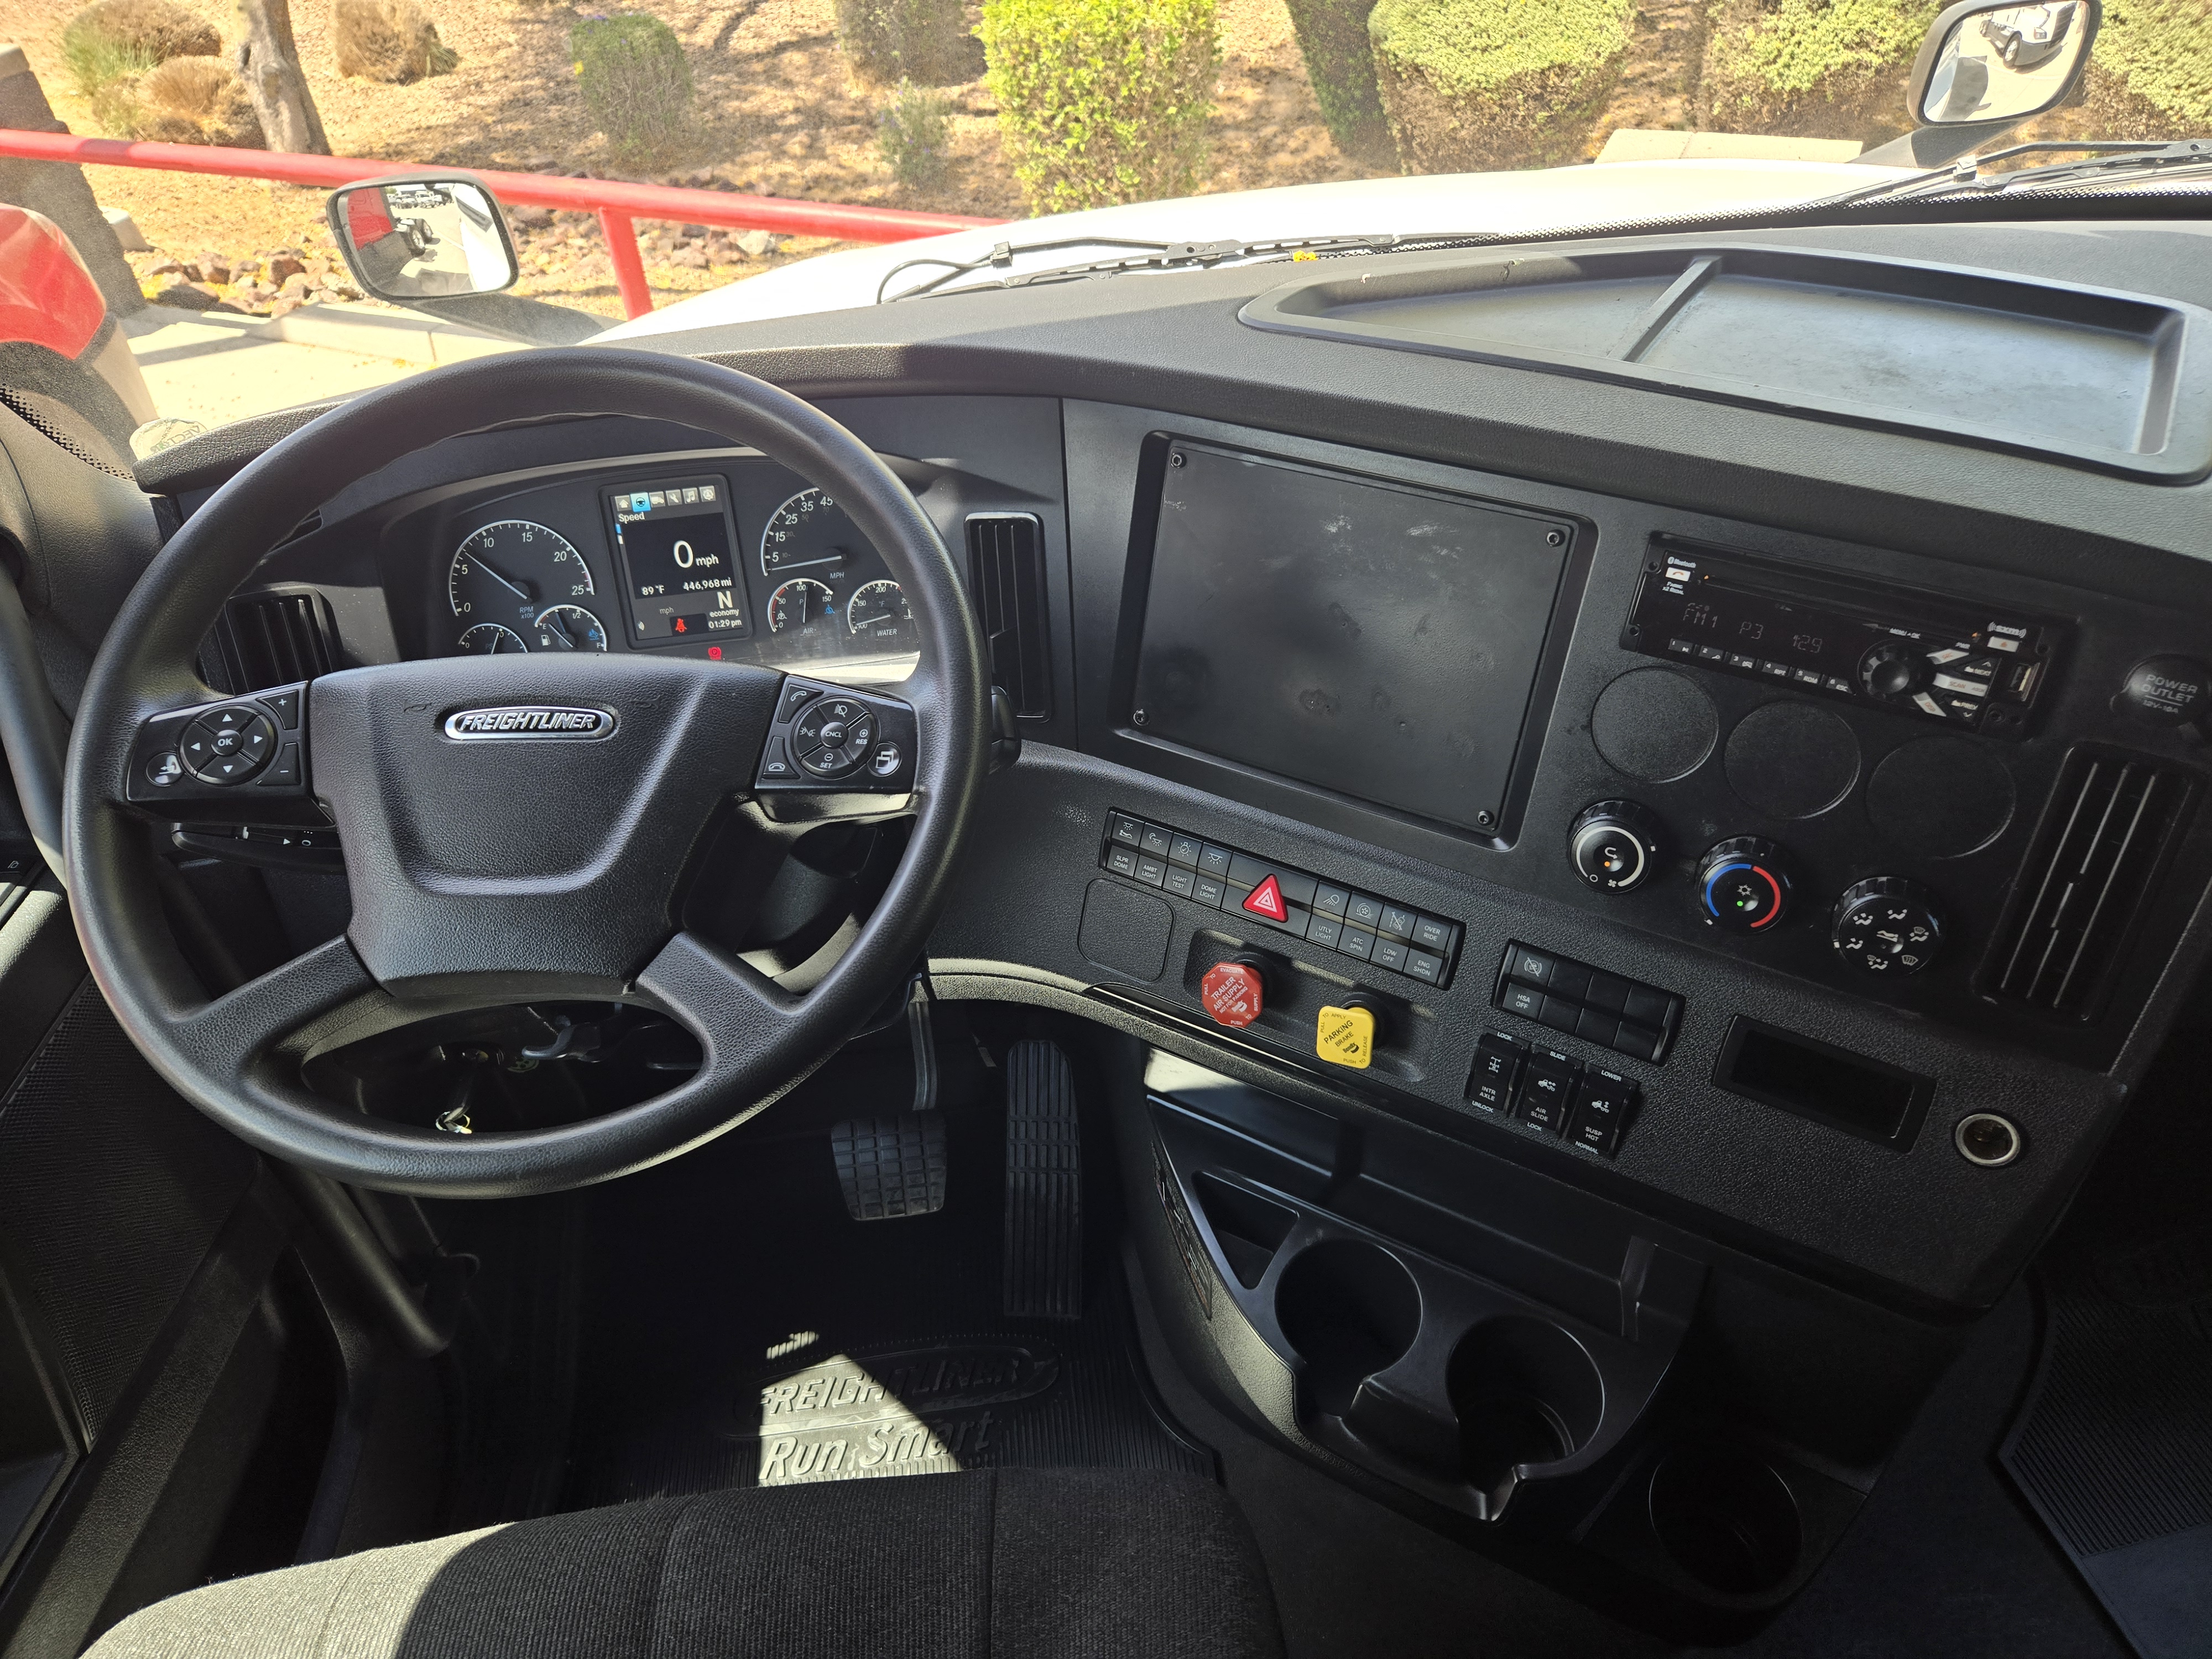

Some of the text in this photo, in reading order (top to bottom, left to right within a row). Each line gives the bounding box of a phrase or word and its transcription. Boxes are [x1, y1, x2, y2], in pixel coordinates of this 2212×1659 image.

[820, 496, 833, 506] 45
[800, 501, 814, 512] 35
[618, 512, 645, 524] Speed
[785, 513, 798, 525] 25
[522, 532, 533, 542] 15
[775, 531, 786, 542] 15
[483, 538, 494, 548] 10
[554, 551, 567, 562] 20
[673, 540, 719, 568] 0 mph
[772, 551, 779, 562] 5
[461, 564, 468, 575] 5
[683, 577, 732, 591] 446,968 mi
[571, 585, 585, 596] 25
[641, 586, 654, 596] 89
[717, 591, 733, 609] N
[463, 602, 471, 612] 0
[660, 607, 674, 615] mph
[709, 609, 739, 618] economy
[708, 619, 742, 629] 01:29 pm
[1739, 621, 1764, 640] P3
[2146, 674, 2198, 693] POWER
[2141, 684, 2194, 703] OUTLET
[460, 712, 596, 731] FREIGHTLINER
[217, 738, 233, 746] OK
[1116, 855, 1129, 863] SLPR
[1114, 860, 1129, 870] DOME
[1143, 864, 1157, 873] AMBT
[1141, 870, 1156, 879] LIGHT
[1172, 874, 1187, 883] LIGHT
[1172, 881, 1185, 889] TEST
[1201, 884, 1217, 894] DOME
[1199, 891, 1215, 900] LIGHT
[1318, 925, 1332, 935] UTLY
[1425, 925, 1441, 935] OVER
[1315, 931, 1331, 941] LIGHT
[1423, 932, 1438, 941] RIDE
[1349, 942, 1363, 952] SPIN
[1384, 947, 1397, 957] LDW
[1417, 960, 1430, 968] ENG
[1413, 966, 1431, 976] SHDN
[1211, 977, 1236, 1000] TRAILER
[1232, 986, 1248, 1001] PARKING
[1213, 978, 1245, 1011] AIR SUPPLY
[1517, 994, 1530, 1003] HSA
[1516, 1001, 1528, 1010] OFF
[1324, 1020, 1353, 1044] PARKING
[1497, 1031, 1512, 1041] LOCK
[1335, 1031, 1354, 1047] BRAKE
[1343, 1042, 1357, 1053] Bendix
[1550, 1051, 1566, 1061] SLIDE
[1601, 1070, 1622, 1082] LOWER
[1481, 1086, 1496, 1095] INTR
[1479, 1091, 1495, 1102] AXLE
[1472, 1100, 1493, 1113] UNLOCK
[1536, 1106, 1546, 1115] AIR
[1531, 1110, 1548, 1121] SLIDE
[1527, 1122, 1542, 1131] LOCK
[1585, 1126, 1603, 1136] SUSP
[1585, 1133, 1599, 1142] HGT
[1575, 1141, 1599, 1154] NORMAL
[758, 1411, 994, 1480] Run Smart
